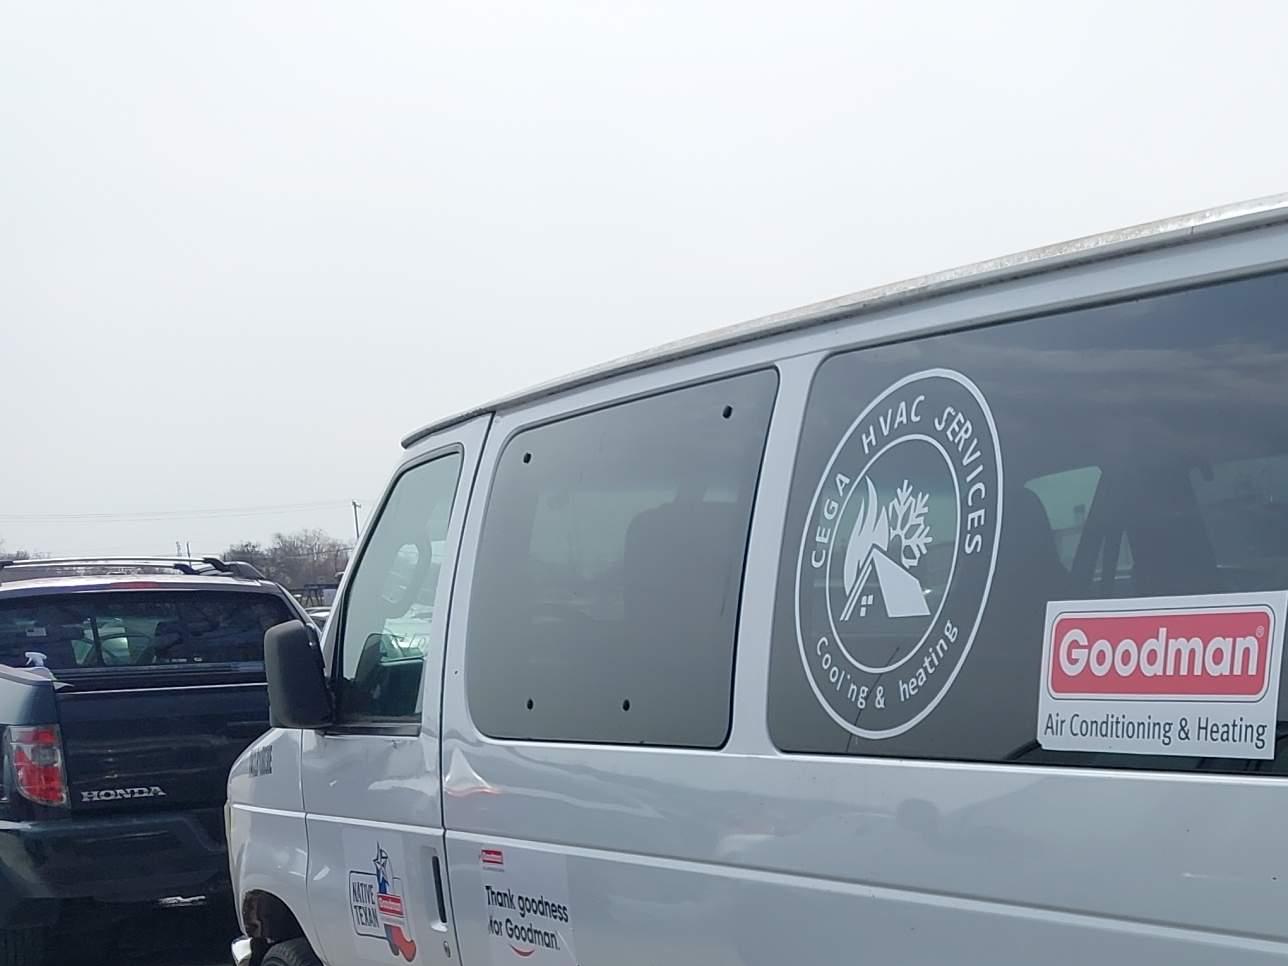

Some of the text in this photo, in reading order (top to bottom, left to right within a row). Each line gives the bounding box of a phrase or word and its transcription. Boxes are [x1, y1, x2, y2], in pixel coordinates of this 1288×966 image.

[811, 395, 986, 568] CEGA HVAC SERVICES
[874, 686, 886, 709] &
[899, 619, 959, 702] heating
[1059, 627, 1259, 677] Goodman
[1044, 713, 1267, 750] Air Conditioning & Heating
[81, 786, 167, 802] HONDA
[352, 882, 376, 904] NATIVE
[485, 885, 569, 922] Thank goodness
[354, 905, 380, 928] TEXAN
[505, 918, 561, 951] Goodman.
